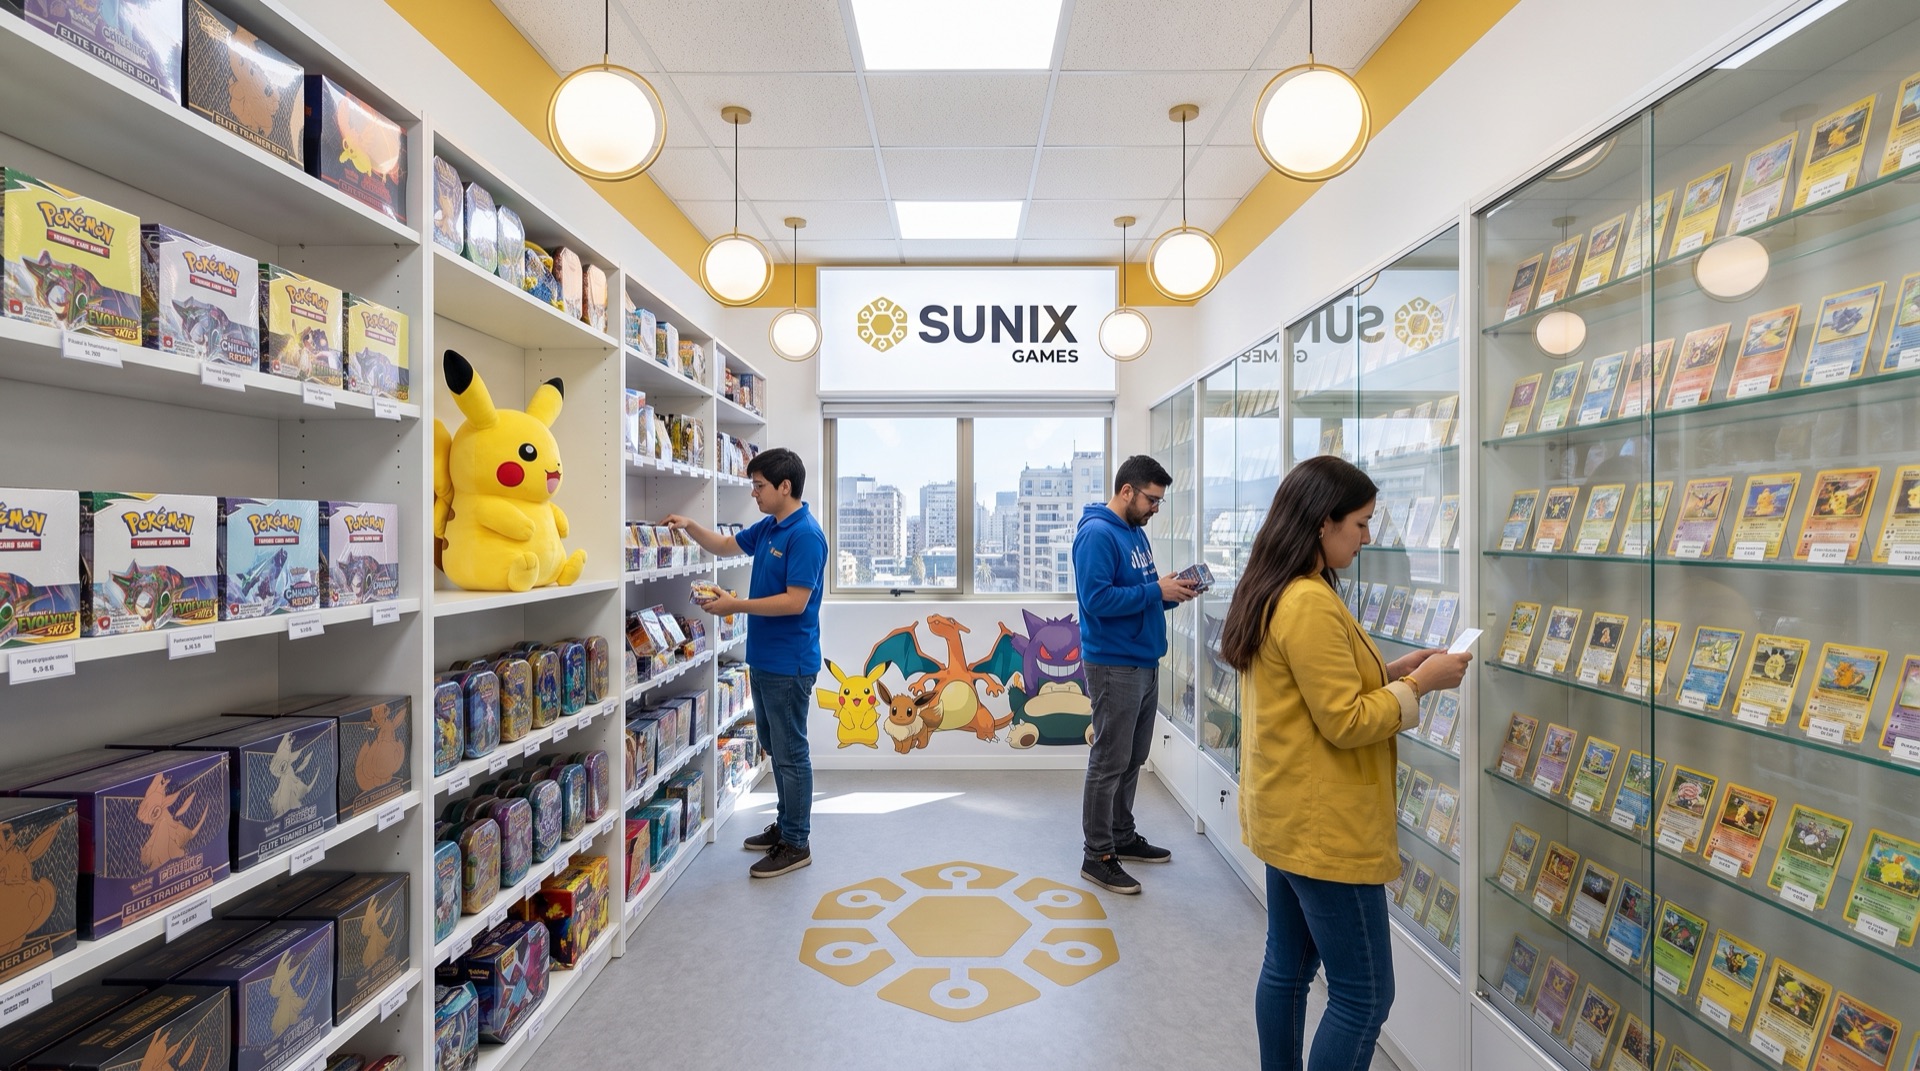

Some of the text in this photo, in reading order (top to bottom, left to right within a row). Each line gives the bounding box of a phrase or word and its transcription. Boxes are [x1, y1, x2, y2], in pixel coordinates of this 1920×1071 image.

[60, 26, 90, 50] ELITE
[91, 43, 135, 75] TRAINER
[215, 114, 238, 133] ELITE
[114, 327, 137, 339] SKIES
[918, 304, 1078, 344] SUNIX
[221, 340, 258, 359] CHILLING
[1012, 349, 1079, 364] GAMES
[121, 506, 195, 536] Pokémon
[47, 622, 74, 636] SKIES
[260, 840, 279, 853] ELITE
[279, 827, 307, 845] TRAINER
[125, 898, 152, 915] ELITE
[153, 879, 191, 903] TRAINER
[192, 870, 209, 885] BOX
[23, 942, 47, 960] BOX
